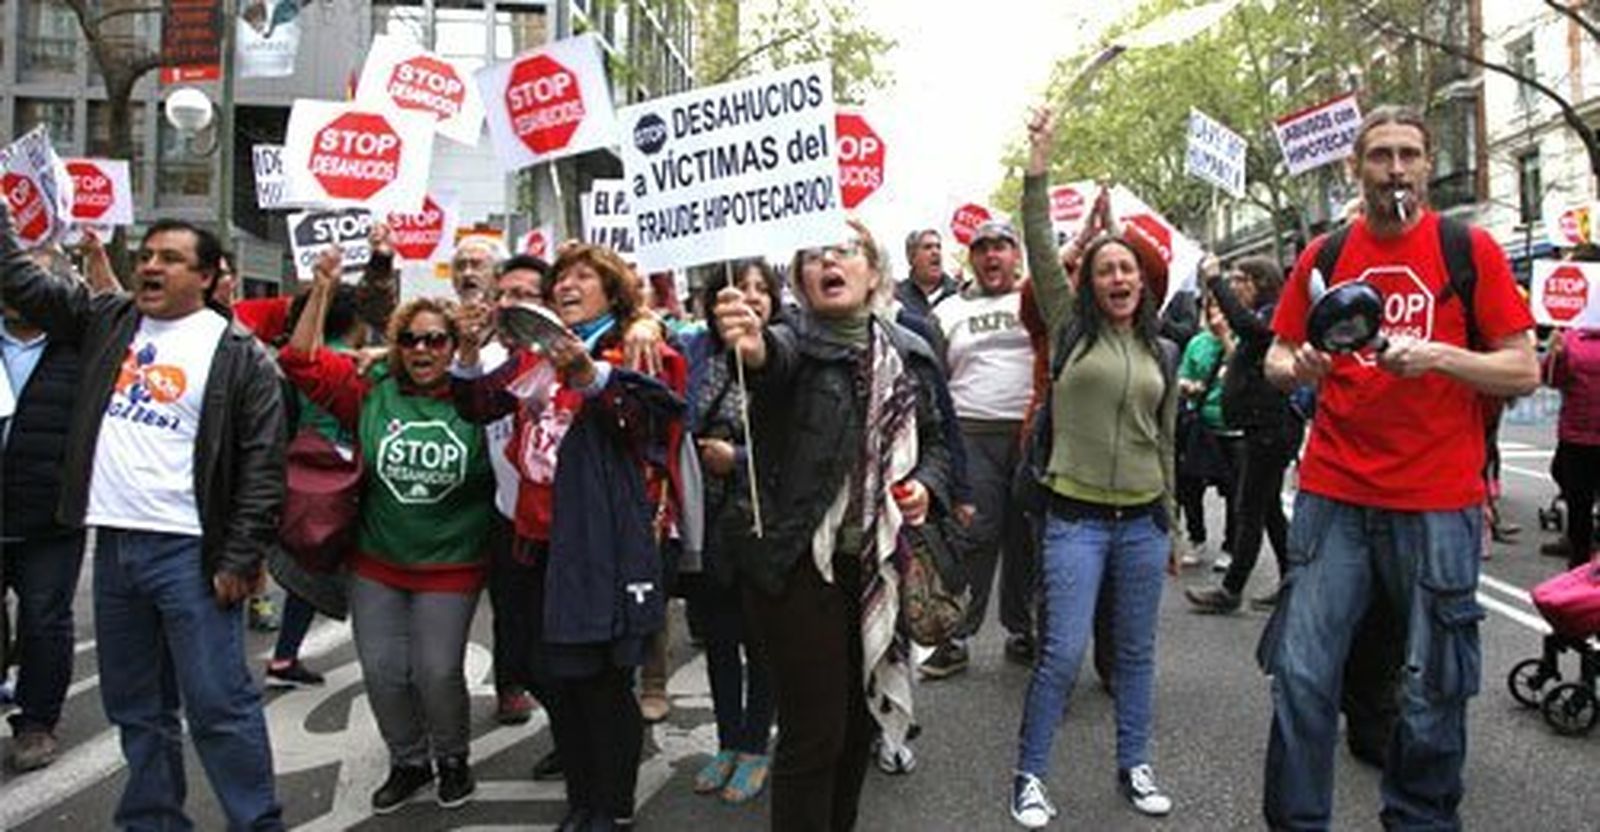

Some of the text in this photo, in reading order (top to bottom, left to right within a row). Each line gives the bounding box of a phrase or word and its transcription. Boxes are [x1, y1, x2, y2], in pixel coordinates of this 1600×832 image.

[397, 64, 461, 98] STOP
[509, 72, 571, 110] STOP
[672, 75, 823, 139] DESAHUCIOS
[320, 129, 398, 156] STOP
[837, 133, 878, 161] OP
[312, 154, 396, 181] DESAHUCIOS
[633, 124, 828, 199] a VÍCTIMAS del
[72, 175, 107, 192] TOP
[393, 210, 440, 228] STOP
[637, 175, 835, 245] FRAUDE HIPOTECARIO!
[313, 213, 370, 243] STOP
[1548, 276, 1586, 294] STOP
[1384, 293, 1425, 324] OP
[387, 439, 460, 471] STOP
